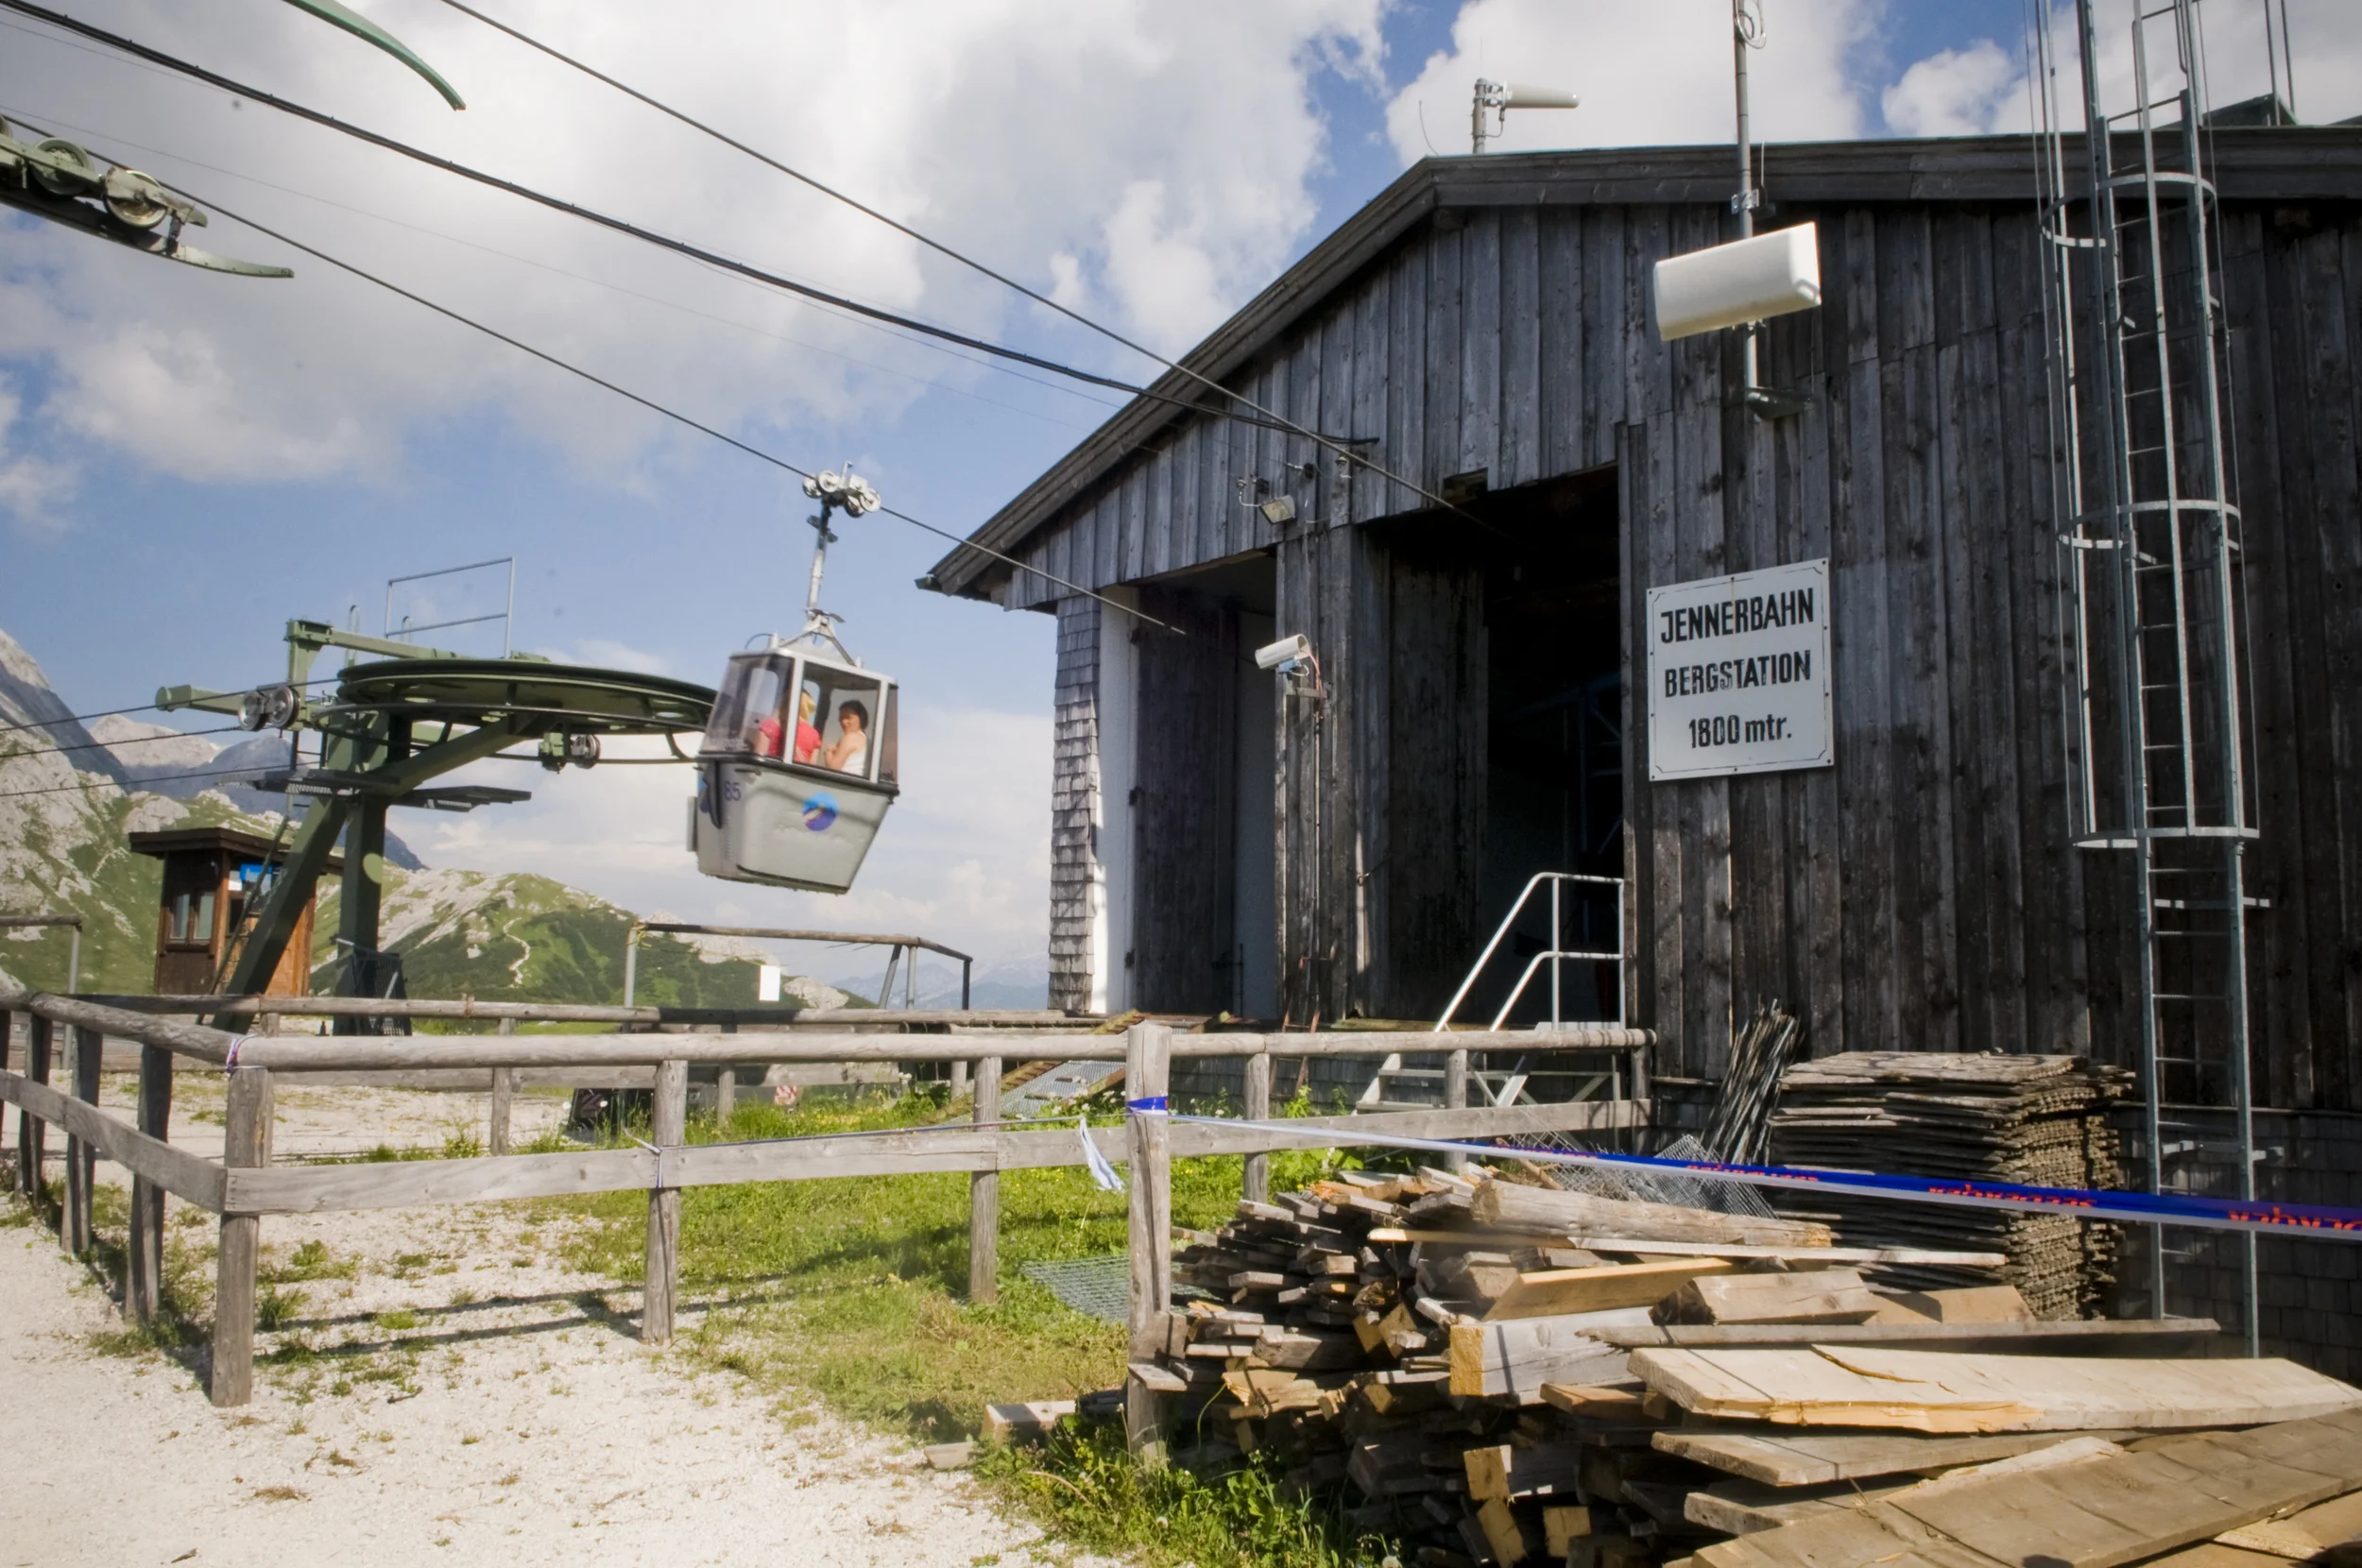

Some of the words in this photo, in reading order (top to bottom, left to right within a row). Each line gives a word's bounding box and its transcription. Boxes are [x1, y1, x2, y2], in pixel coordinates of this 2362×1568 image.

[1660, 588, 1814, 643] JENNERBAHN
[1665, 650, 1811, 698] BERGSTATION
[1688, 715, 1740, 749] 1800
[1745, 714, 1792, 743] mtr.
